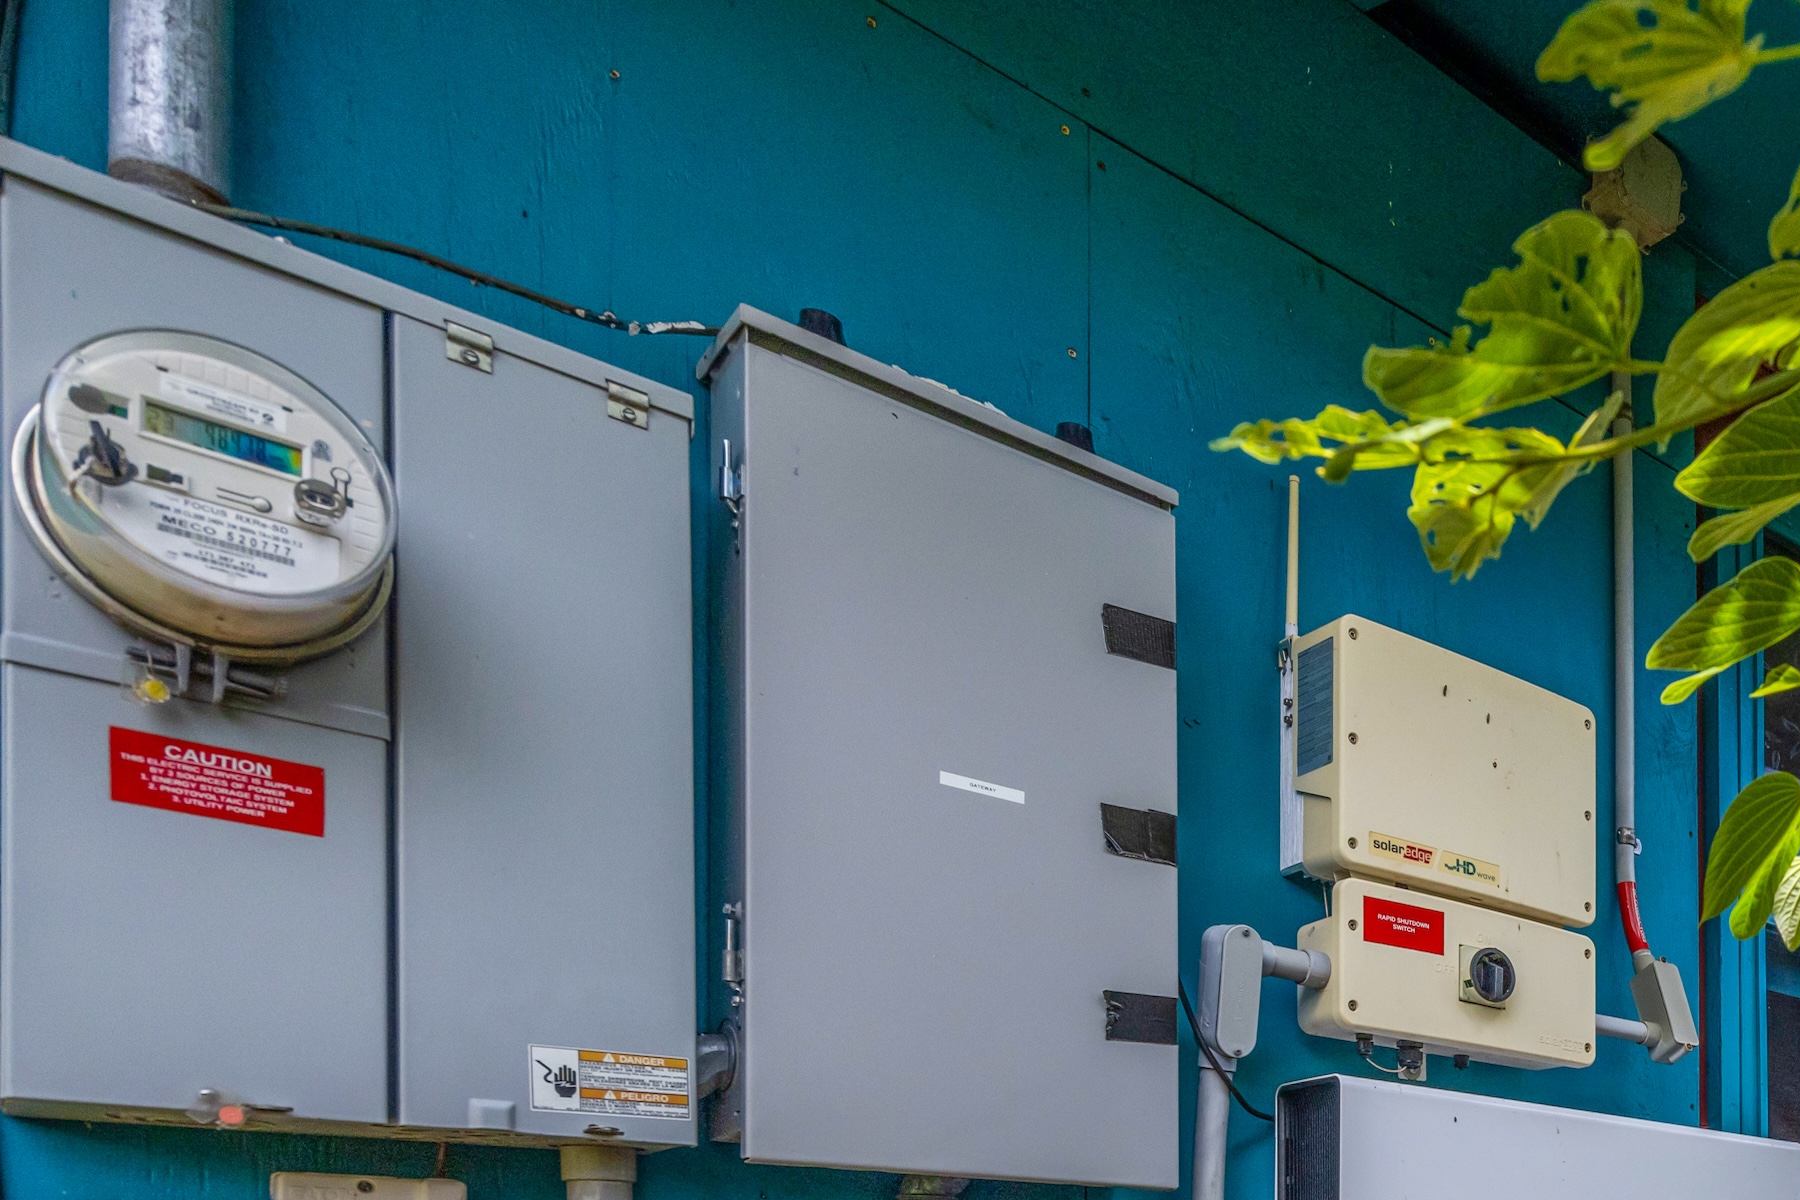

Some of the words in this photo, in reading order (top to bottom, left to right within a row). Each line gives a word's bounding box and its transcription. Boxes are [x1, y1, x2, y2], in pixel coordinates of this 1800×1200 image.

[183, 499, 228, 518] FOCUS
[162, 514, 216, 536] MECO
[227, 533, 292, 556] 520777
[164, 745, 272, 777] CAUTION
[120, 752, 145, 763] THIS
[146, 757, 200, 773] ELECTRIC
[203, 768, 248, 782] SERVICE
[251, 777, 261, 785] IS
[264, 780, 312, 795] SUPPLIED
[149, 766, 165, 775] BY
[176, 771, 228, 787] SOURCES
[247, 784, 286, 797] POWER
[151, 774, 197, 788] ENERGY
[199, 784, 251, 799] STORAGE
[253, 793, 295, 807] SYSTEM
[969, 782, 997, 793] GATEWAY
[159, 785, 244, 806] PHOTOVOLTAIC
[246, 800, 287, 814] SYSTEM
[183, 797, 223, 810] UTILITY
[225, 804, 265, 818] POWER
[1373, 839, 1433, 864] solaredge
[1456, 859, 1476, 876] HD
[1477, 872, 1496, 882] wave
[1377, 913, 1396, 923] RAPID
[1397, 917, 1430, 929] SHUTDOWN
[1392, 924, 1416, 933] SWITCH
[1434, 963, 1455, 975] OFF
[619, 1055, 665, 1066] DANGER
[620, 1092, 669, 1103] PELIGRO
